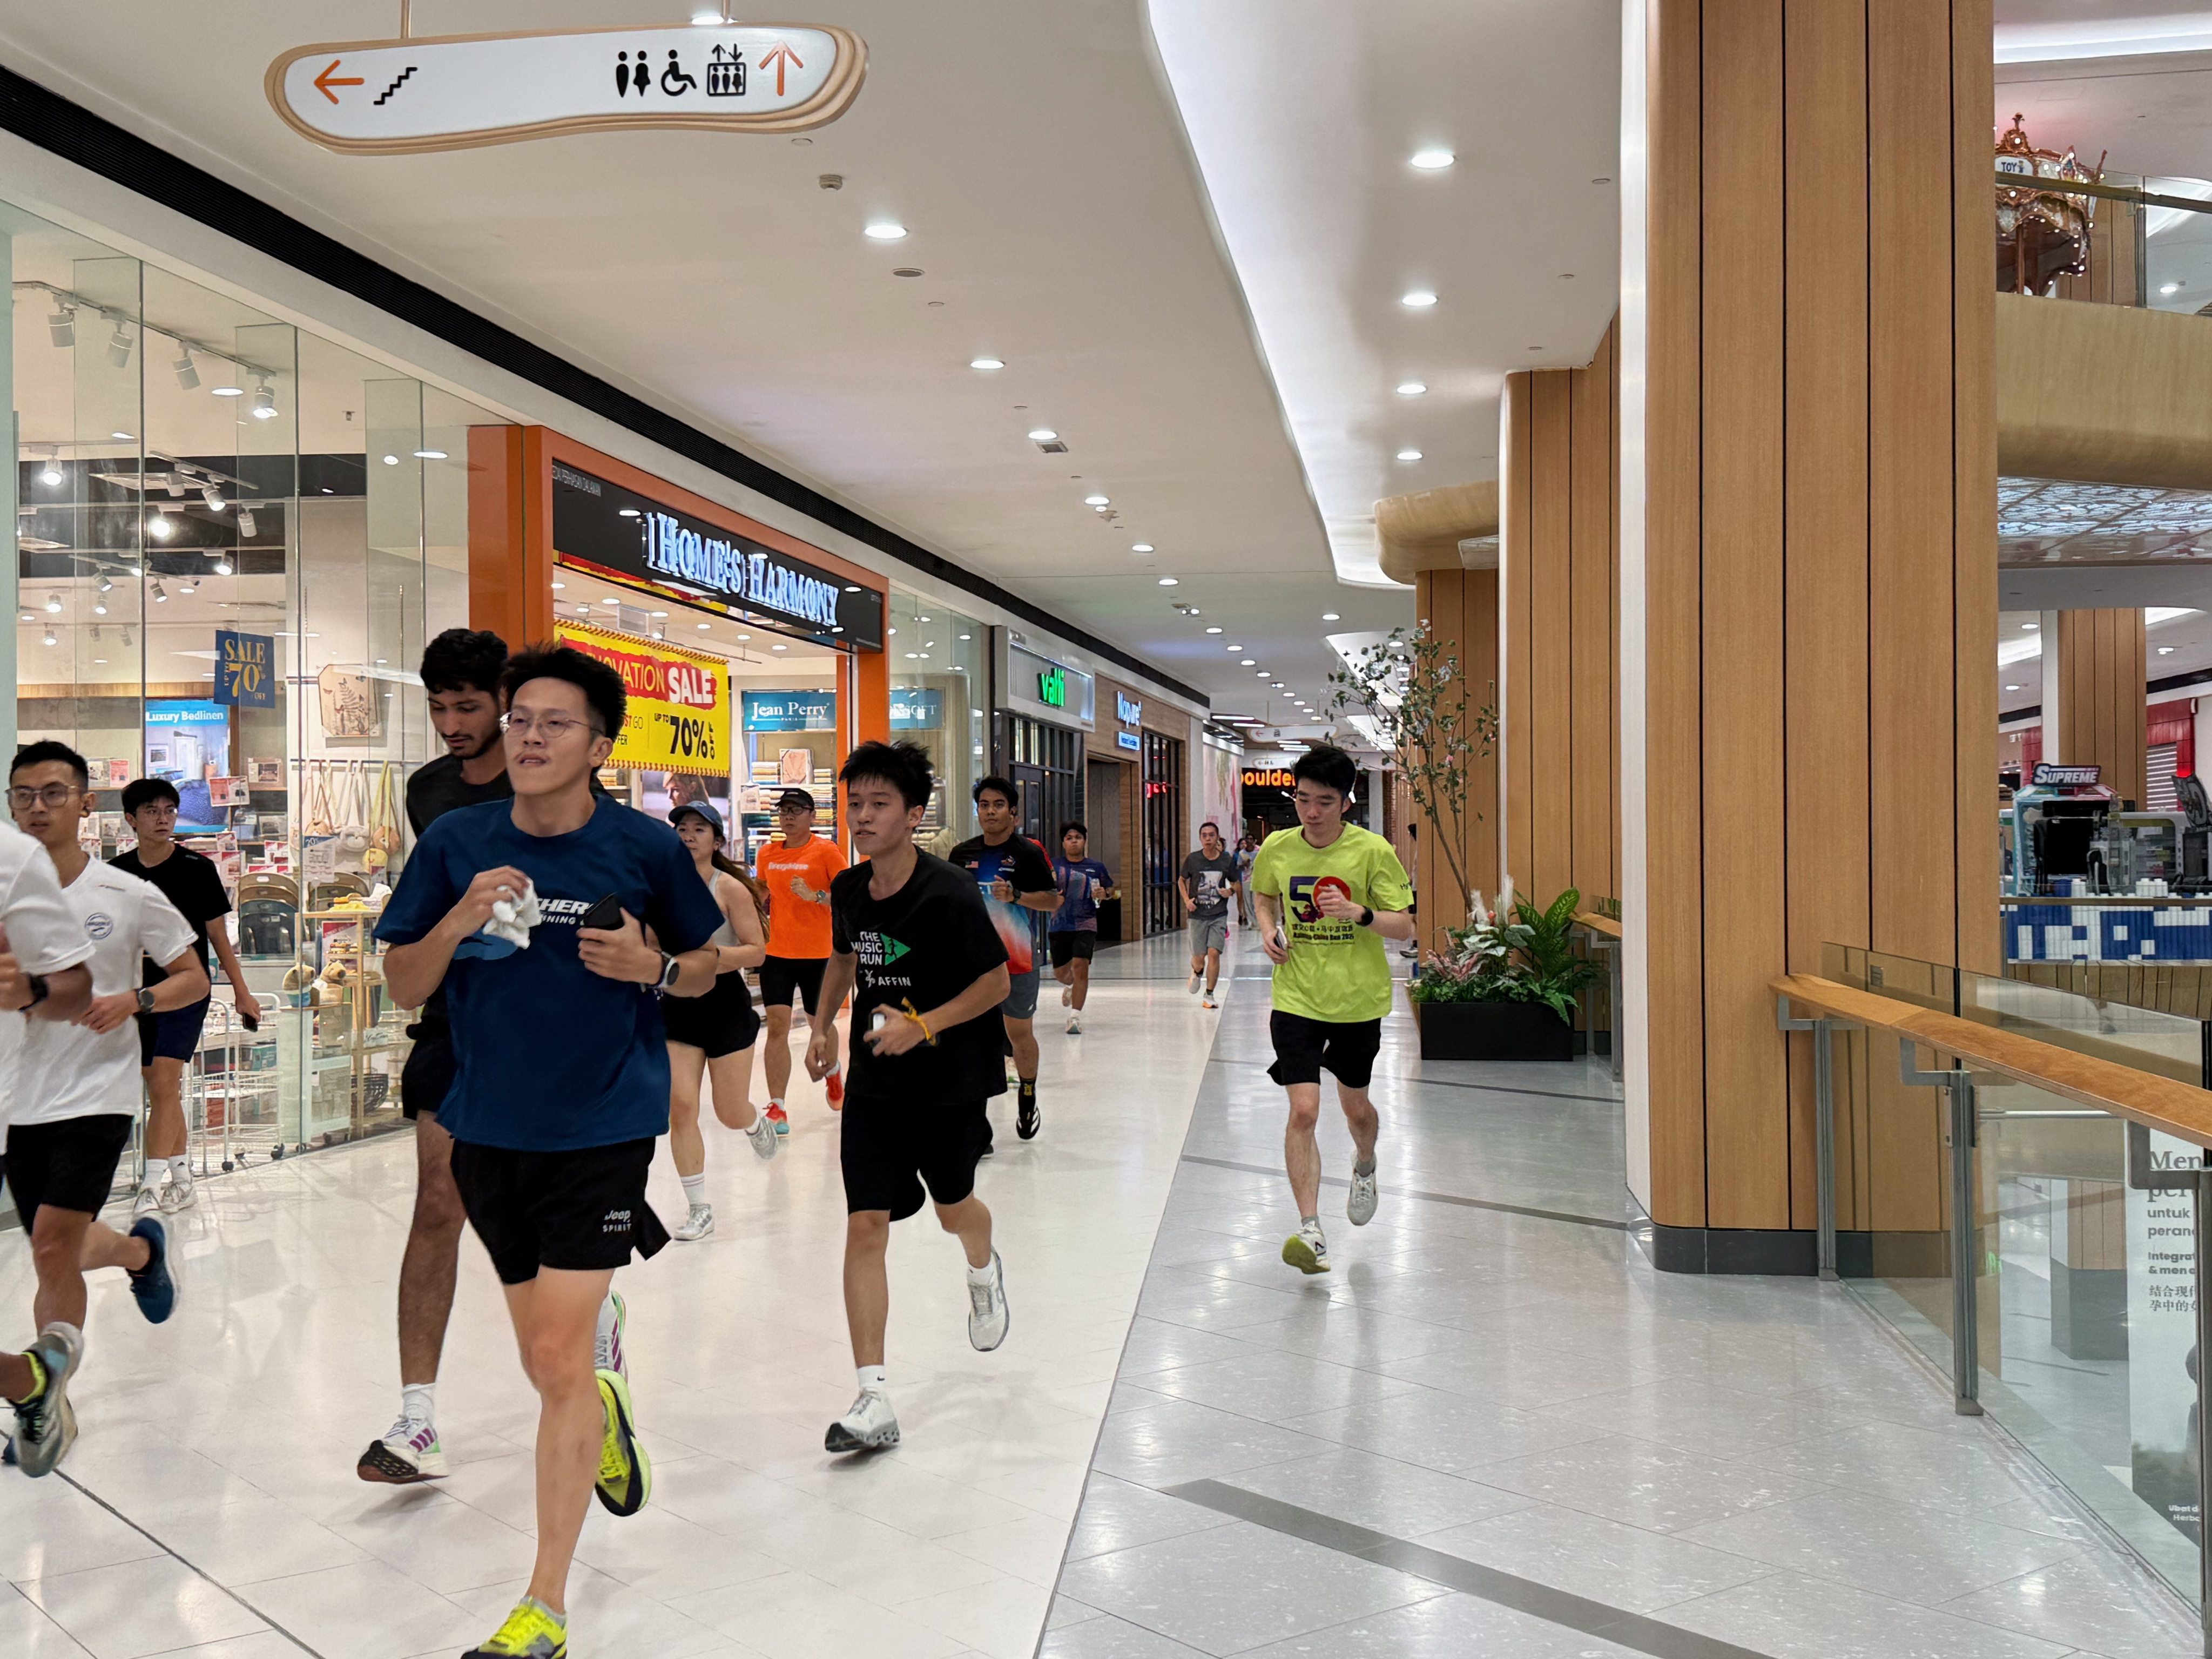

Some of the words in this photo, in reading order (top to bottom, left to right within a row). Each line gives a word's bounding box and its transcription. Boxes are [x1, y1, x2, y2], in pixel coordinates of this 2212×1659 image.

[2001, 161, 2017, 172] TOY
[657, 511, 741, 594] HOME'S
[749, 554, 839, 626] HARMONY
[225, 638, 266, 664] SALE
[667, 667, 713, 704] SALE
[146, 712, 180, 724] Luxury
[181, 711, 224, 721] Bedlinen
[752, 702, 783, 721] Jean
[788, 702, 827, 720] Perry
[633, 716, 644, 730] GO
[654, 713, 662, 722] UP
[663, 714, 669, 723] TO
[670, 715, 708, 759] 70%
[2034, 766, 2099, 784] SUPREME
[860, 931, 880, 942] THE
[851, 942, 883, 953] MUSIC
[860, 954, 883, 965] RUN
[878, 976, 912, 987] AFFIN
[2147, 1208, 2190, 1219] untuk
[603, 1224, 632, 1233] SPIRIT
